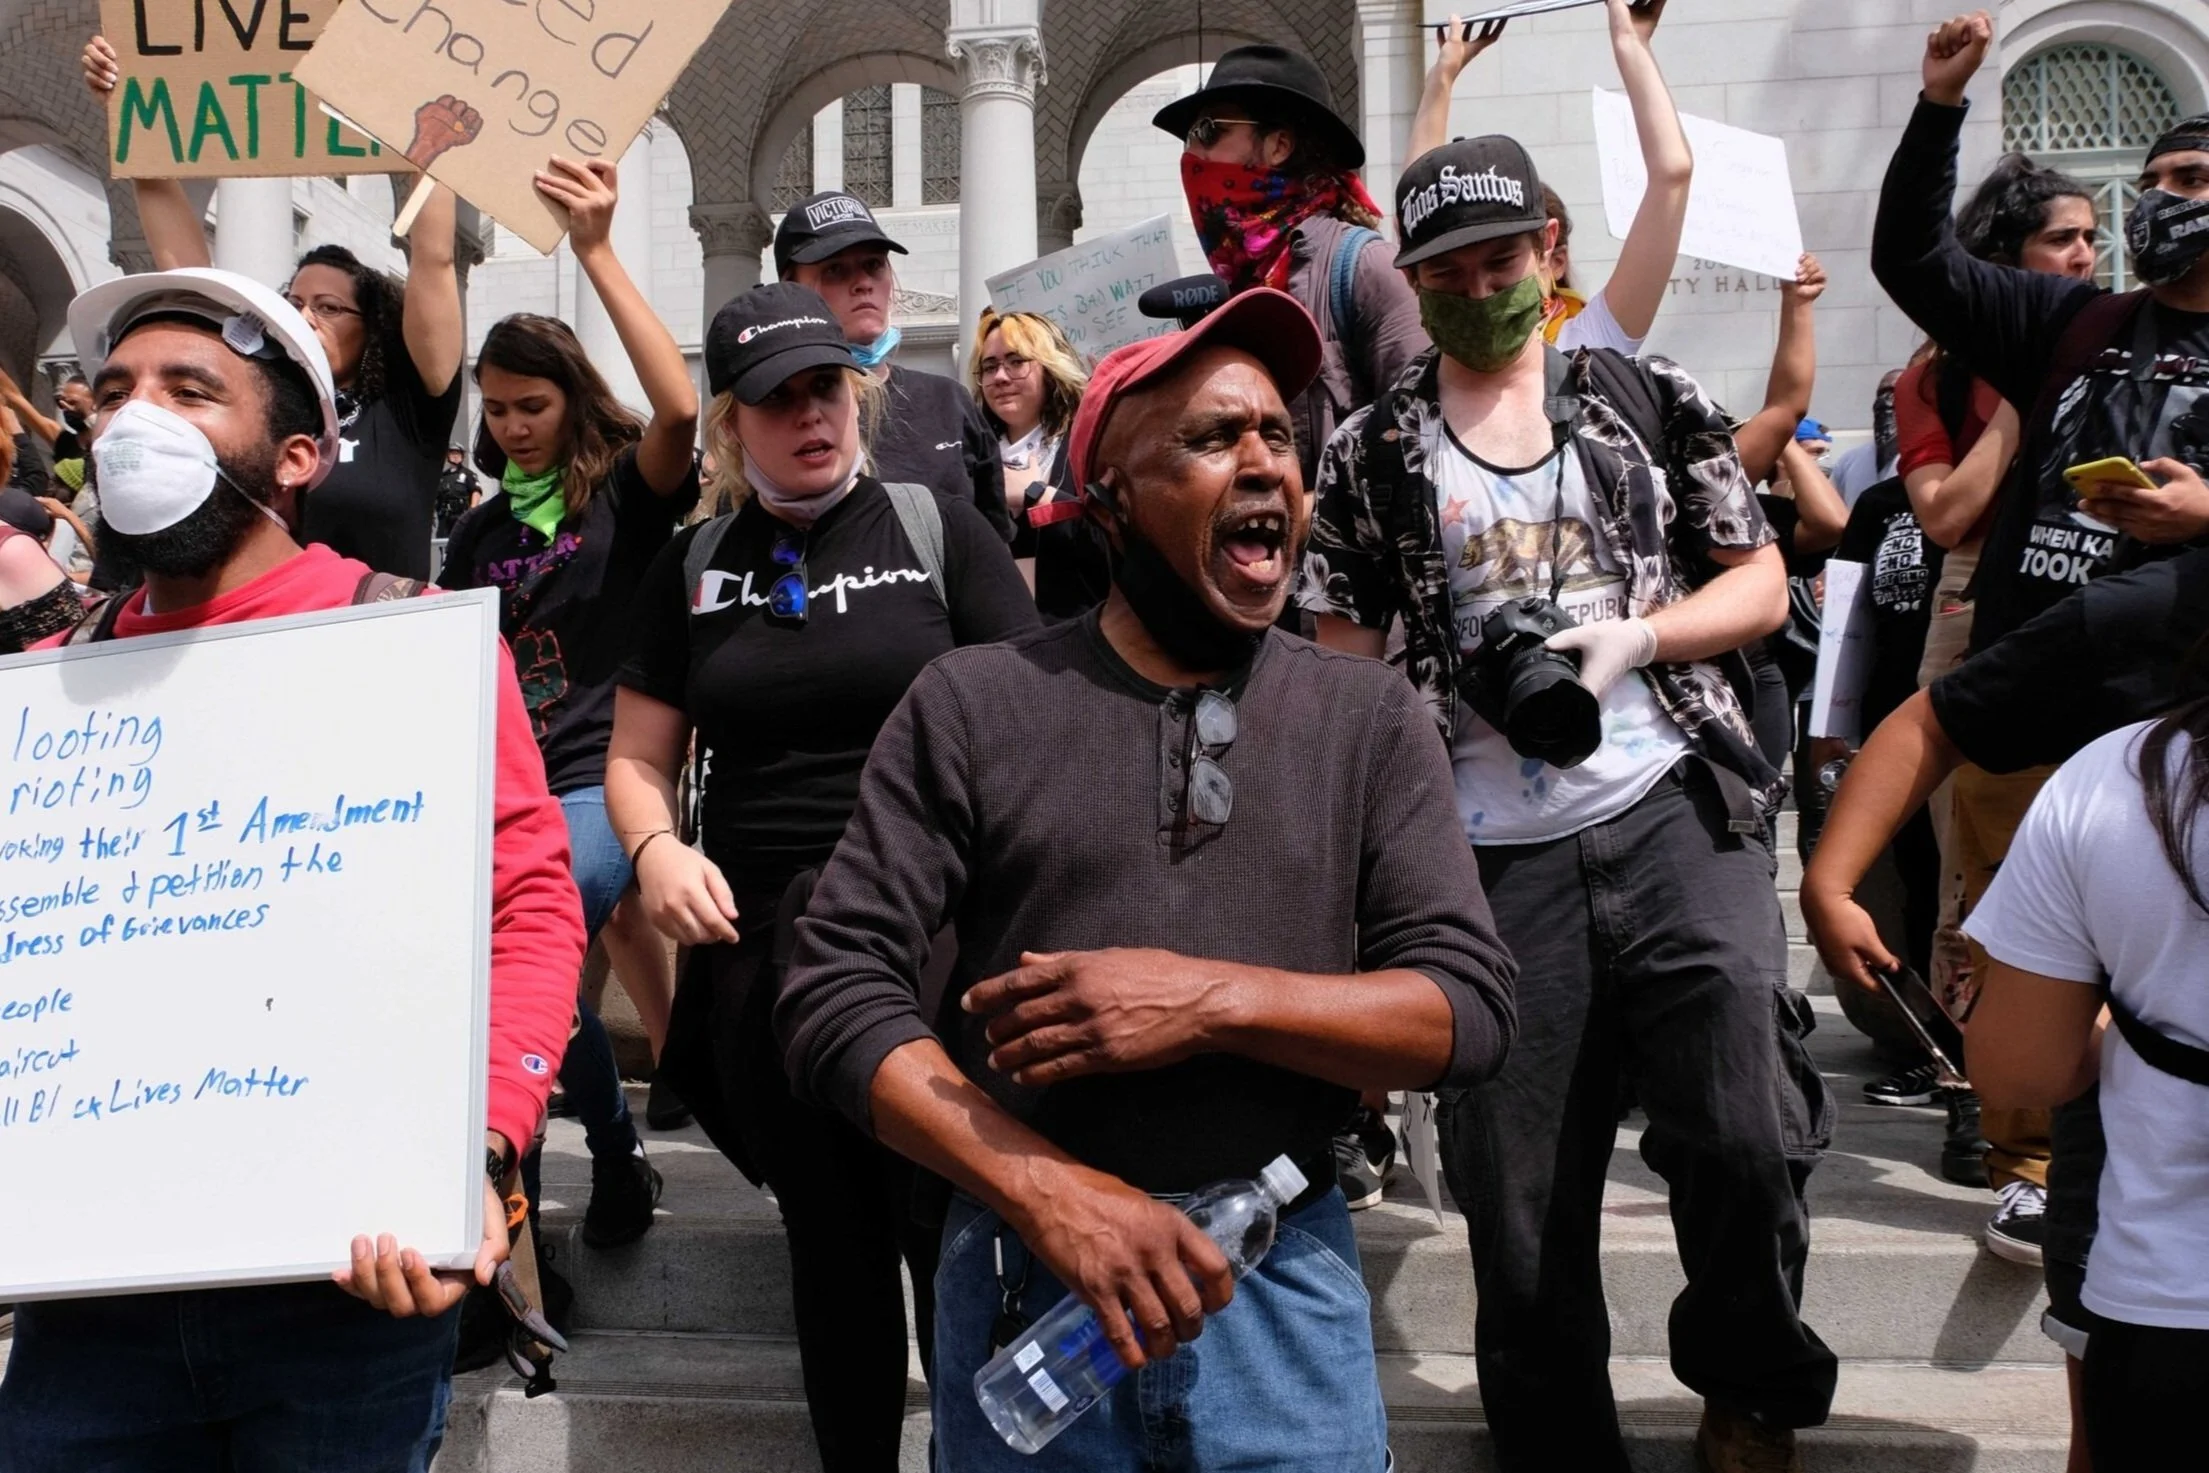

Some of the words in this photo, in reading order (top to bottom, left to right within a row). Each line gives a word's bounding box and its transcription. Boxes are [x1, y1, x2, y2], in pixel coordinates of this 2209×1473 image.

[133, 0, 316, 55] LIVE
[1401, 186, 1439, 239] Los
[1439, 164, 1526, 209] Santos
[996, 277, 1026, 309] IF
[1036, 268, 1062, 293] YOU
[1130, 230, 1168, 252] THAT
[1669, 276, 1700, 295] TY
[1074, 287, 1107, 315] BAD
[1108, 273, 1155, 301] WAIT
[738, 316, 828, 344] Champion
[1092, 306, 1127, 334] SEE
[2029, 524, 2080, 550] WHEN
[2081, 534, 2114, 559] KA
[2019, 546, 2094, 585] TOOK
[13, 706, 162, 767] looting
[10, 765, 152, 815] rioting
[79, 826, 147, 860] their
[148, 858, 264, 910] petition
[280, 842, 343, 883] the
[79, 912, 116, 948] of
[109, 1079, 181, 1114] Lives
[194, 1065, 310, 1101] Matter
